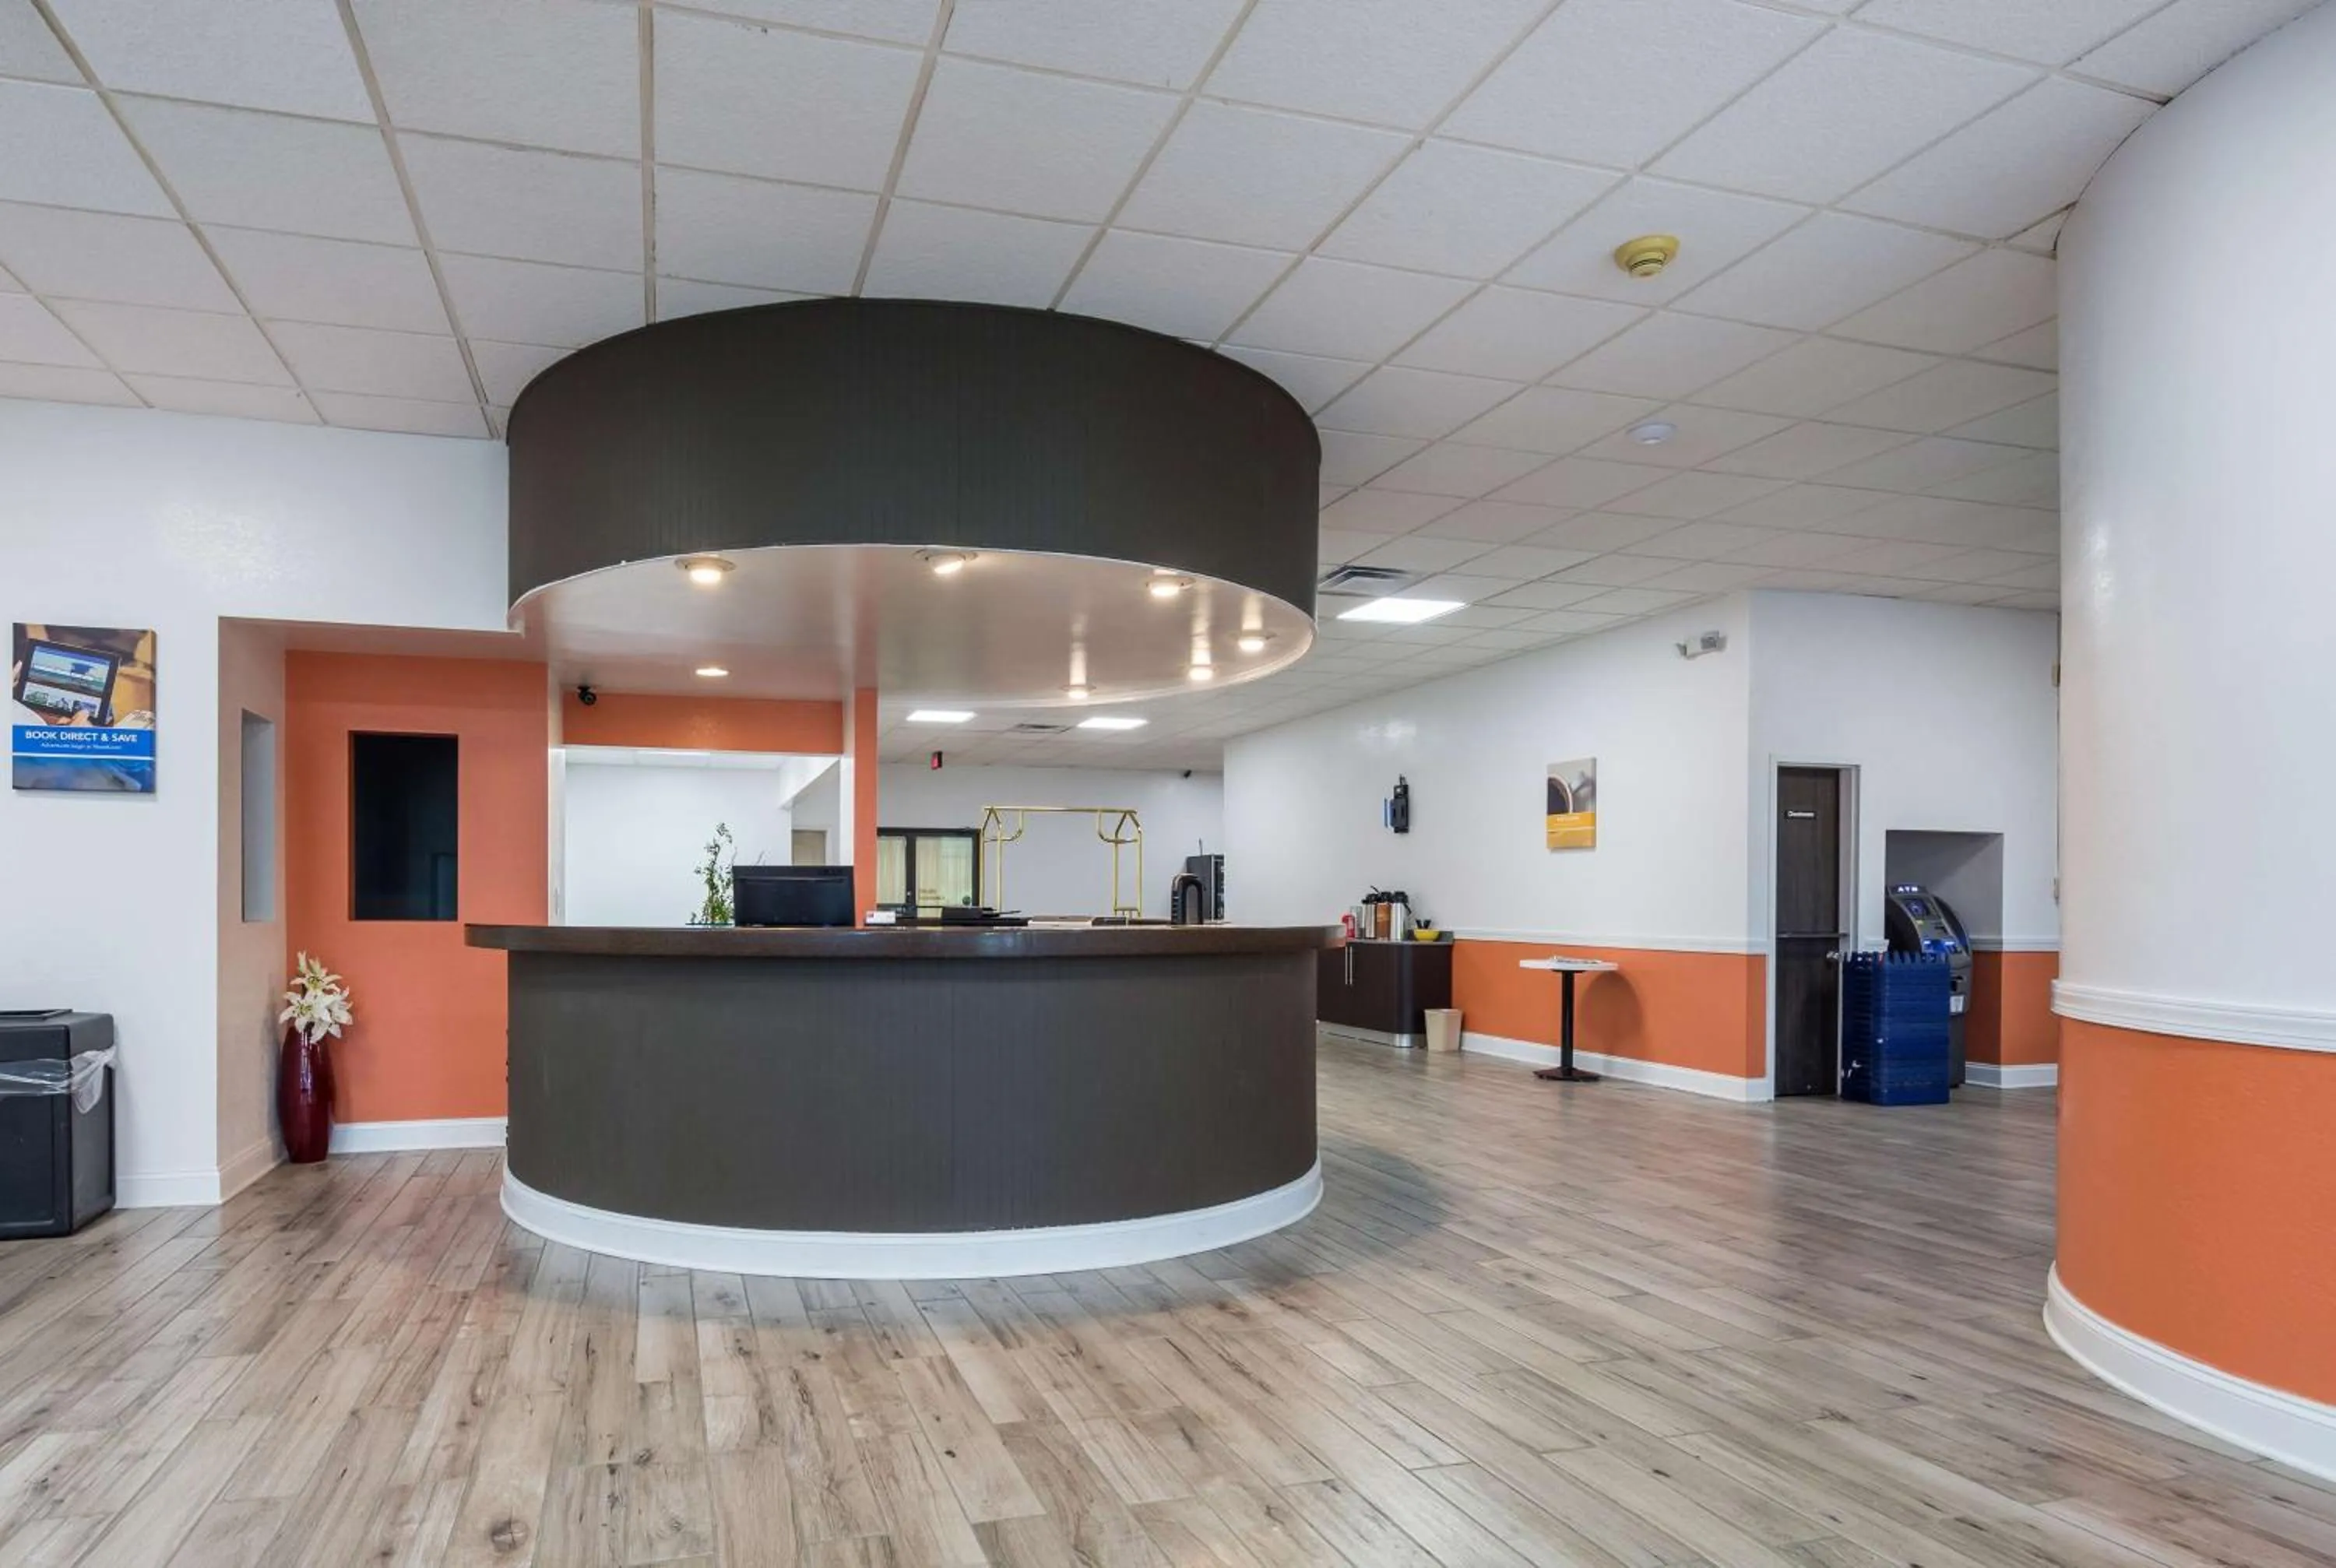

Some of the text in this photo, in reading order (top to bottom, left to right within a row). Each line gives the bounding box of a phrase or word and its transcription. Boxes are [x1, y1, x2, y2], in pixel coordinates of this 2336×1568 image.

[25, 730, 138, 743] BOOK DIRECT & SAVE
